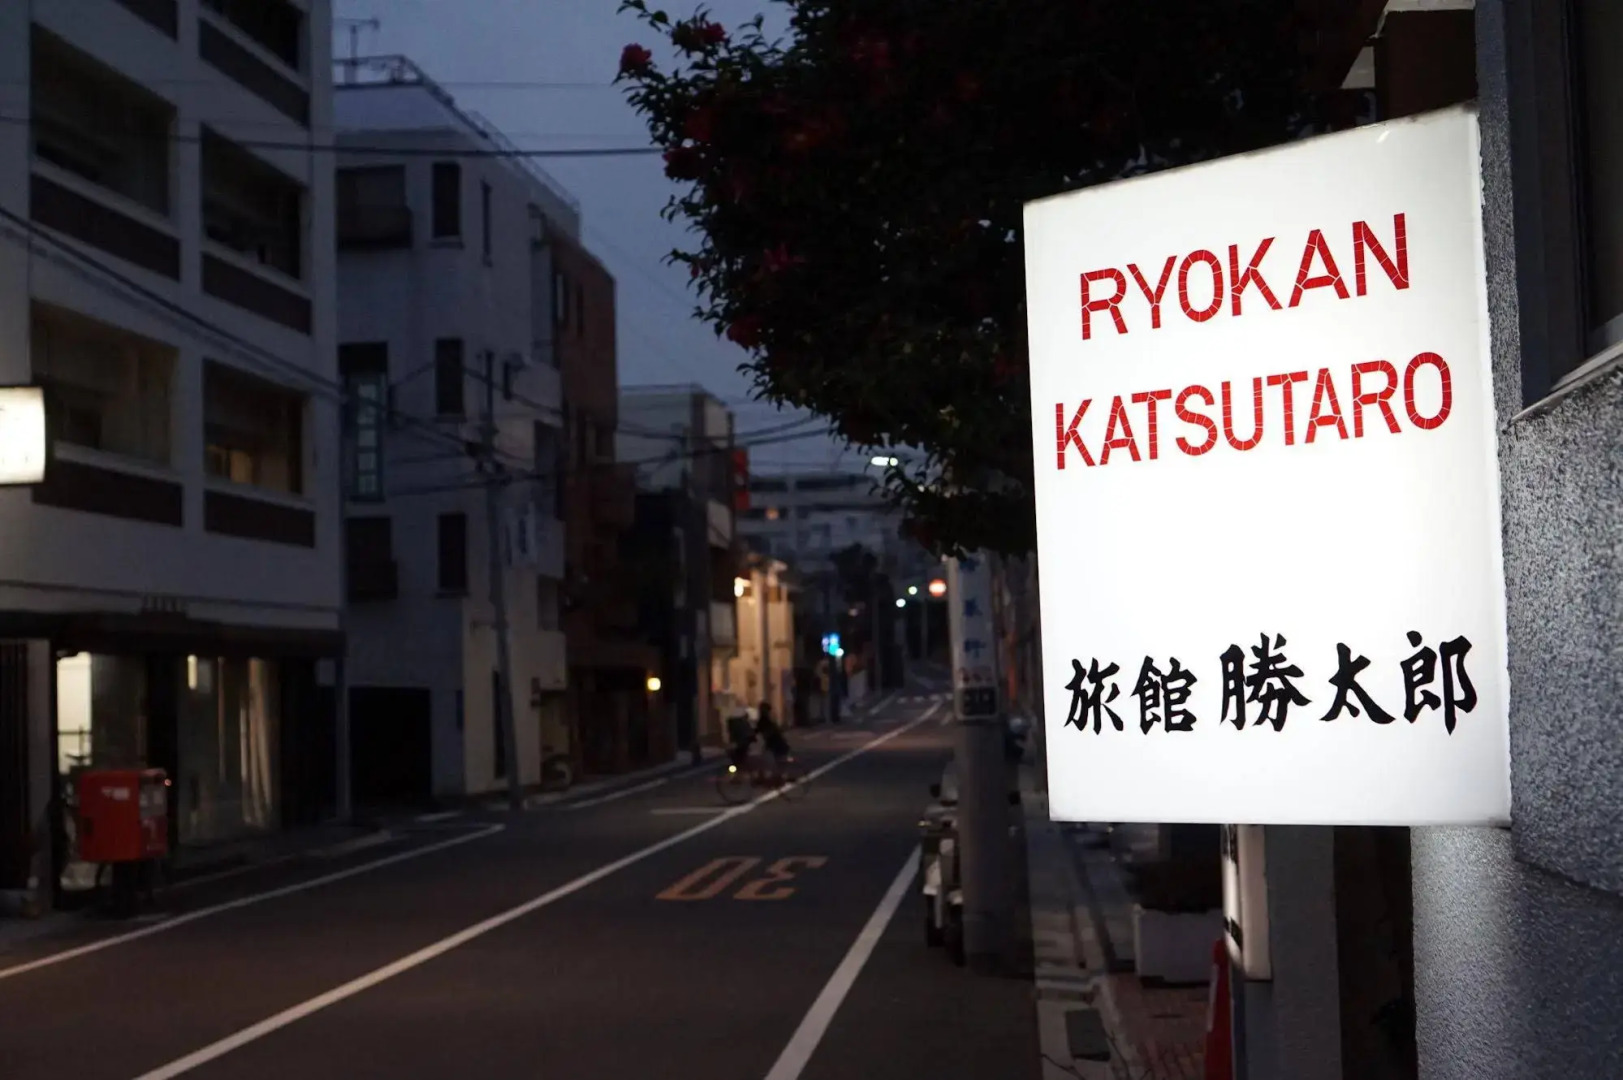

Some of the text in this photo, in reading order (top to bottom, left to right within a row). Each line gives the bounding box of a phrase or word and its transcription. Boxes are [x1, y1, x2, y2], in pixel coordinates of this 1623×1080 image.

[1080, 213, 1409, 340] RYOKAN
[1055, 351, 1452, 470] KATSUTARO
[1064, 630, 1478, 736] 旅館 勝太郎
[655, 855, 829, 901] 30
